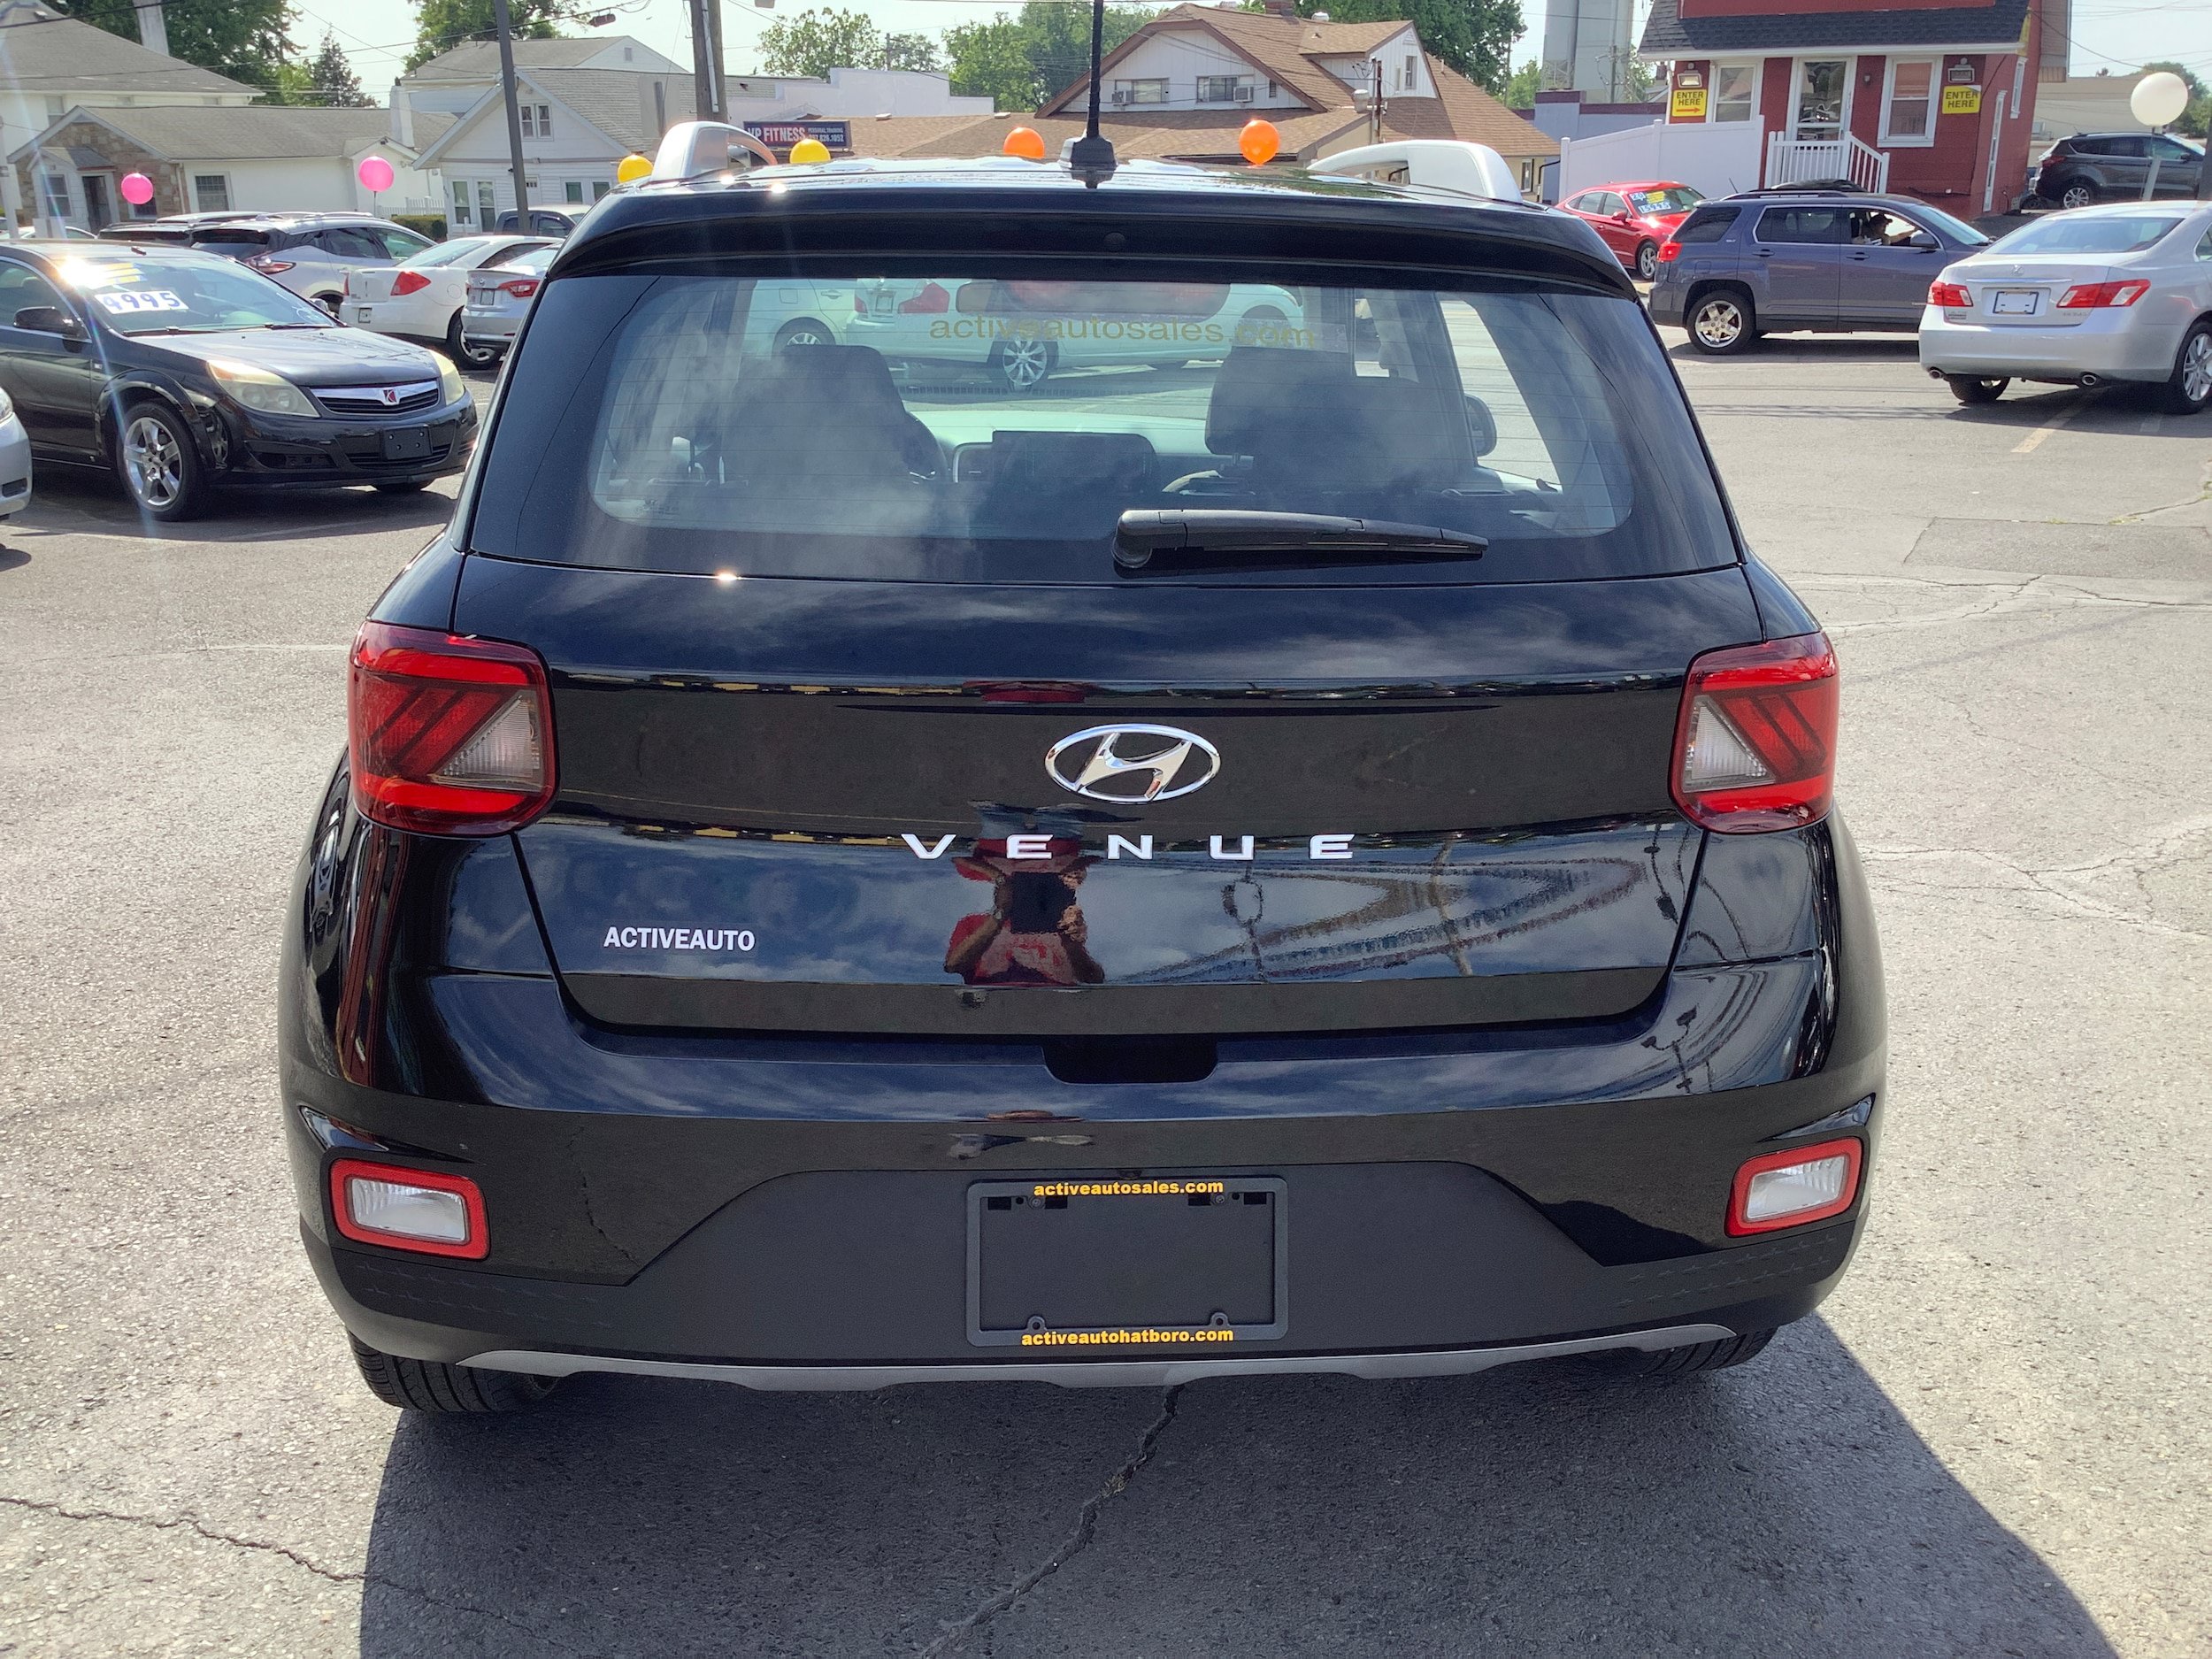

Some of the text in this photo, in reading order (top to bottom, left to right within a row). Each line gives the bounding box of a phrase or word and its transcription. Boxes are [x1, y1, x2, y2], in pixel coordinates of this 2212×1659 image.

[1946, 90, 1978, 100] ENTER
[1947, 99, 1975, 108] HERE
[764, 127, 806, 142] FITNESS
[928, 313, 1316, 348] activeautosales.com
[900, 833, 1356, 860] VENUE
[603, 926, 756, 951] ACTIVEAUTO
[1033, 1180, 1224, 1196] activeautosales.com
[1021, 1329, 1233, 1346] activeautohatboro.com
